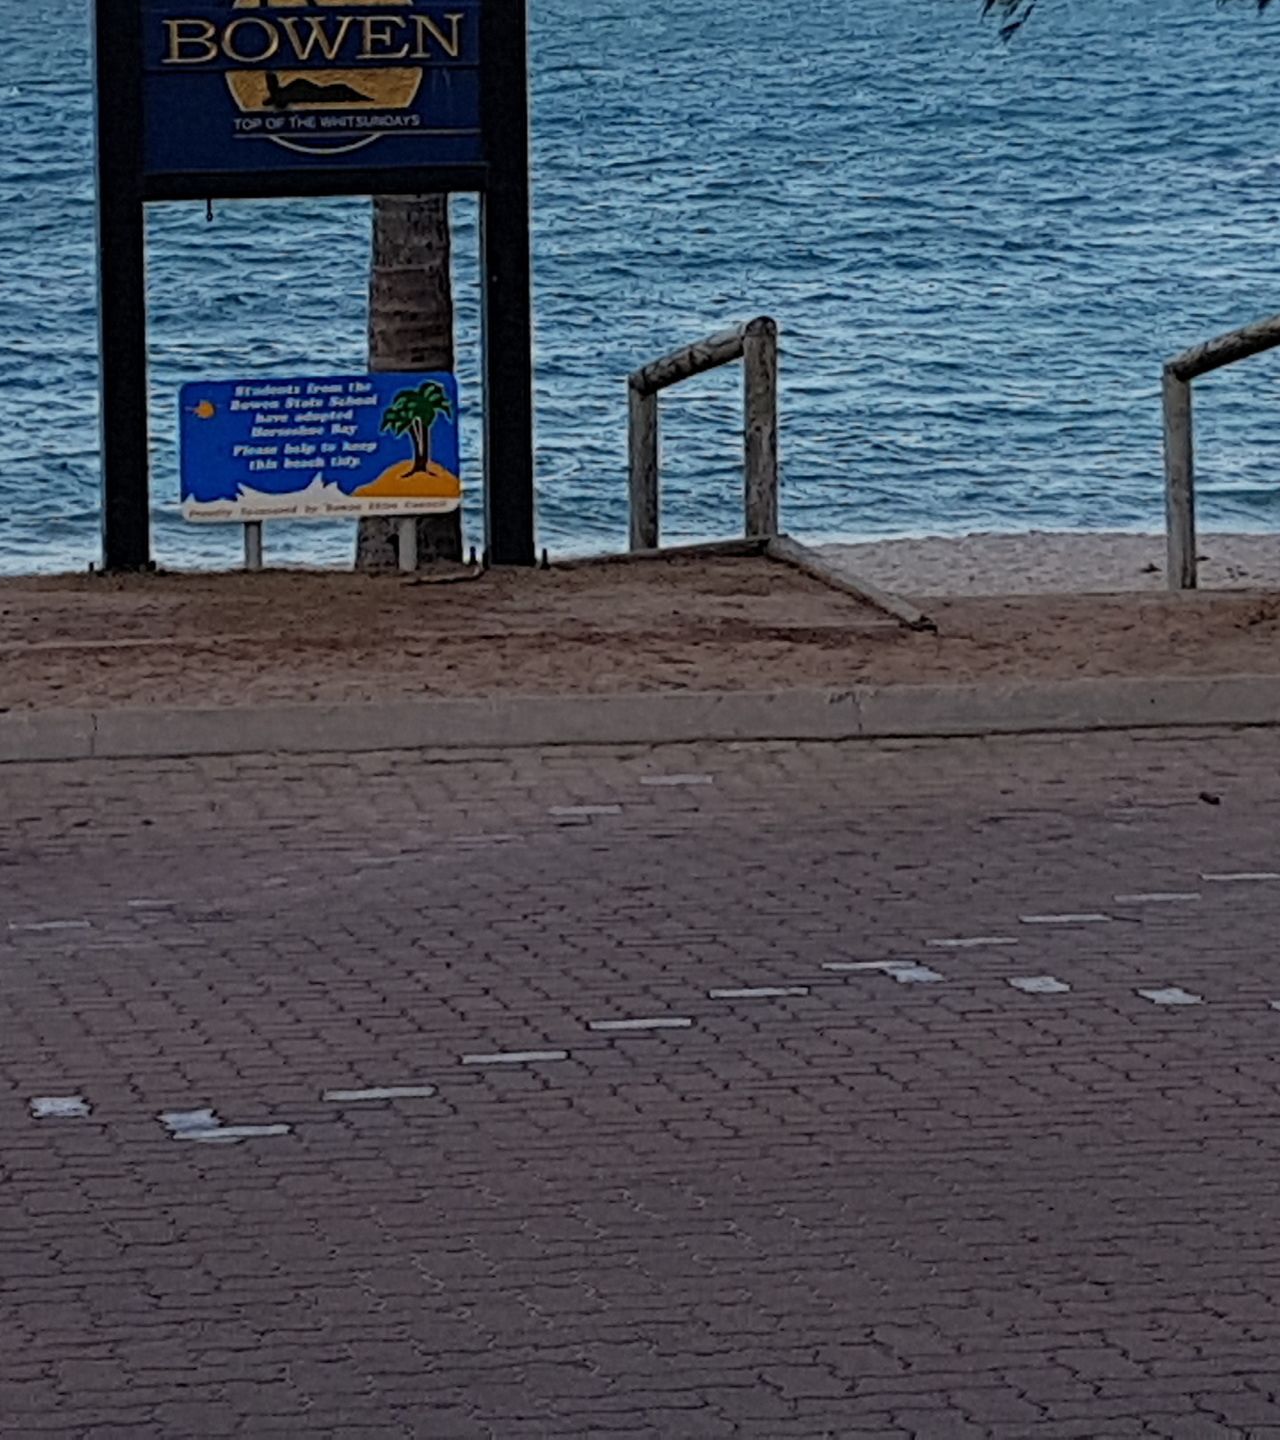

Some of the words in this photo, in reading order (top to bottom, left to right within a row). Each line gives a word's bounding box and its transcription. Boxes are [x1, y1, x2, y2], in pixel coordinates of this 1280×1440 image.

[161, 13, 464, 64] BOWEN
[233, 118, 262, 130] TOP
[265, 117, 285, 130] OF
[289, 116, 317, 129] THE
[320, 114, 421, 128] WHITSUNDAYS
[235, 384, 301, 397] Students
[306, 382, 343, 394] from
[348, 381, 372, 393] the
[230, 399, 280, 411] Bowen
[285, 397, 324, 409] State
[328, 394, 378, 407] School
[255, 413, 289, 424] have
[294, 409, 354, 423] adopted
[251, 425, 325, 437] Horseshoe
[330, 423, 358, 436] Bay
[232, 444, 278, 457] Please
[283, 442, 316, 455] help
[320, 442, 337, 453] to
[341, 441, 378, 453] keep
[249, 459, 278, 471] this
[283, 457, 325, 469] beach
